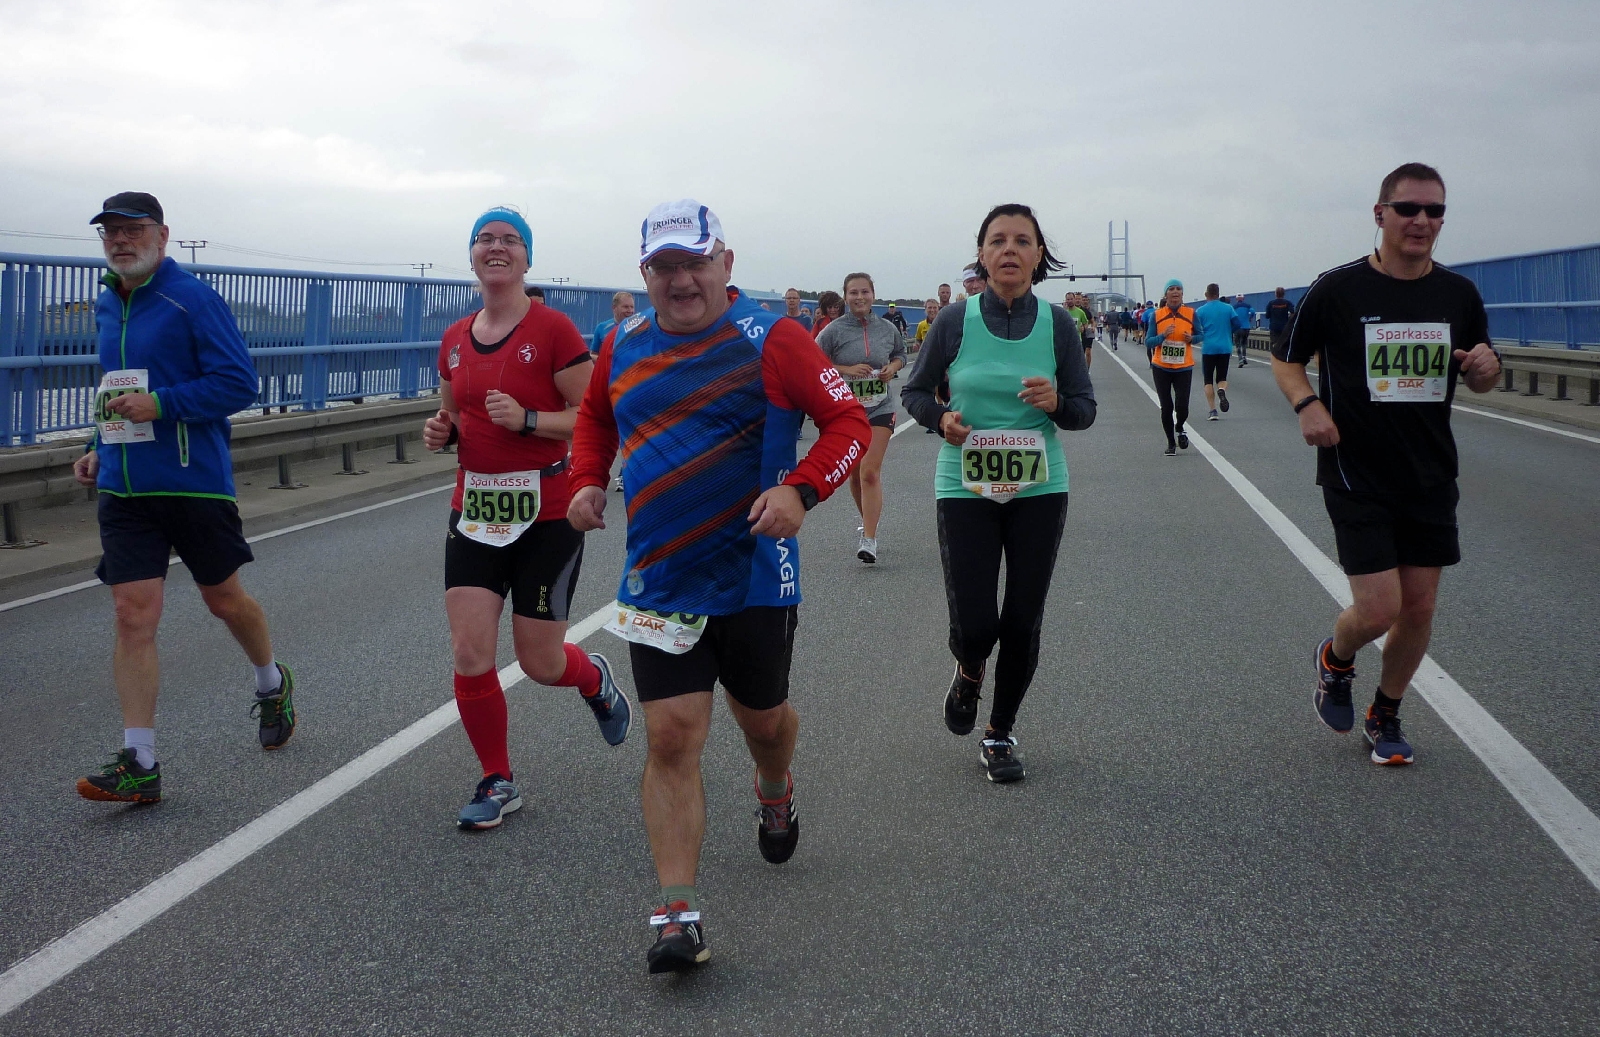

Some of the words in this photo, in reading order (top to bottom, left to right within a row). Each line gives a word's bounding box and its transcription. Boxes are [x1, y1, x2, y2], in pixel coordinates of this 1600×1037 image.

[652, 217, 693, 231] ERDINGER
[736, 316, 764, 339] AS
[1376, 328, 1442, 342] Sparkasse
[1371, 345, 1445, 376] 4404
[106, 376, 138, 386] rkasse
[1397, 378, 1425, 388] DAK
[972, 434, 1036, 448] Sparkasse
[966, 450, 1042, 482] 3967
[470, 476, 530, 488] Sparkasse
[991, 483, 1019, 493] DAK
[466, 490, 535, 522] 3590
[486, 524, 512, 535] DAK
[632, 613, 666, 633] DAK
